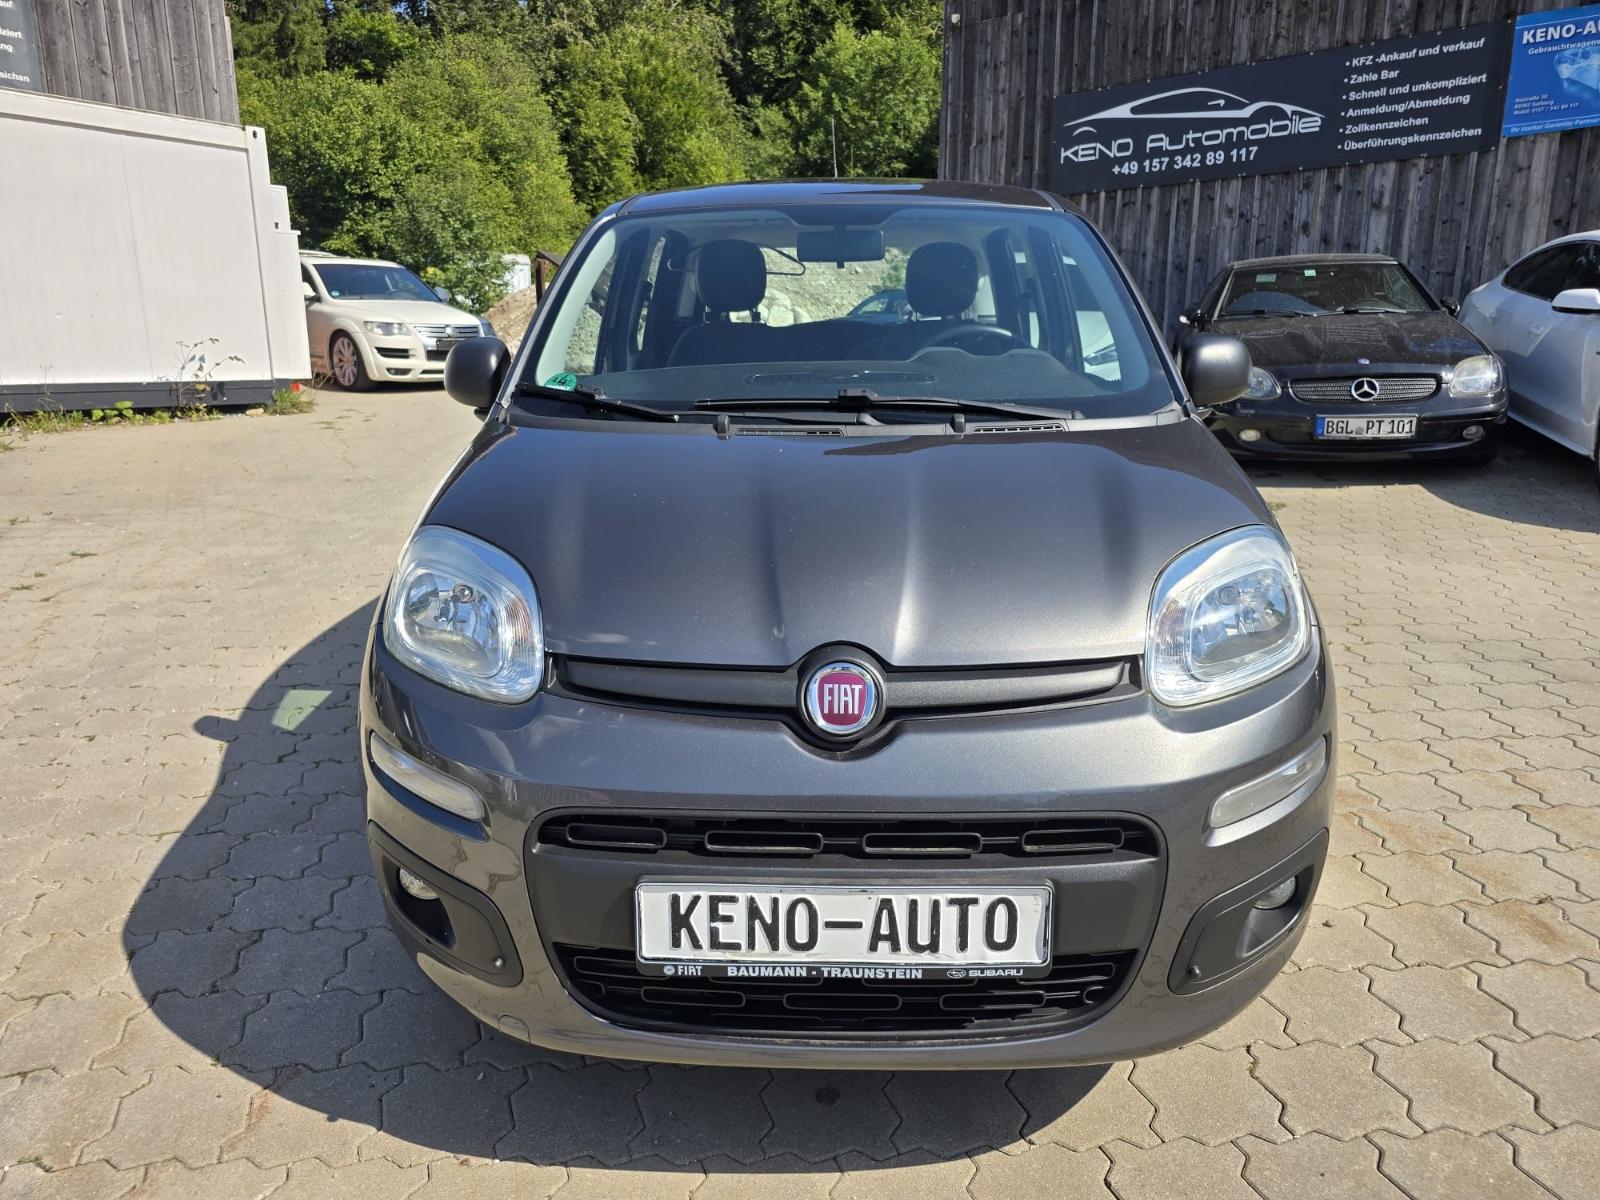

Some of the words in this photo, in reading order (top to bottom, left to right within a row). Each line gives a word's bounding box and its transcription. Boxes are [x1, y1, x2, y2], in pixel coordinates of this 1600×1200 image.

[1522, 18, 1600, 45] KENO-A
[1352, 55, 1373, 67] KFZ
[1418, 45, 1440, 57] und
[1442, 37, 1486, 54] verkauf
[1349, 84, 1387, 101] Schnell
[1389, 81, 1410, 95] und
[1411, 73, 1488, 93] unkompliziert
[1350, 72, 1378, 85] Zahle
[1381, 69, 1400, 80] Bar
[1346, 93, 1471, 118] Anmeldung/Abmeldung
[1345, 116, 1429, 135] Zollkennzeichen
[1060, 138, 1134, 164] KENO
[1146, 115, 1321, 153] Automobile
[1344, 127, 1482, 151] Überführungskennzeichen
[1112, 161, 1138, 175] +49
[1142, 157, 1170, 173] 157
[1173, 153, 1201, 170] 342
[1206, 149, 1225, 165] 89
[1230, 146, 1258, 163] 117
[1326, 420, 1354, 435] BGL
[1366, 419, 1385, 434] PT
[1387, 419, 1414, 434] 101
[823, 683, 864, 715] FIAT
[671, 893, 1019, 954] KENO-AUTO
[677, 965, 703, 976] FIAT
[727, 965, 807, 977] BAUMANN
[821, 967, 923, 979] TRAUNSTEIN
[968, 968, 1024, 977] SUBARU
